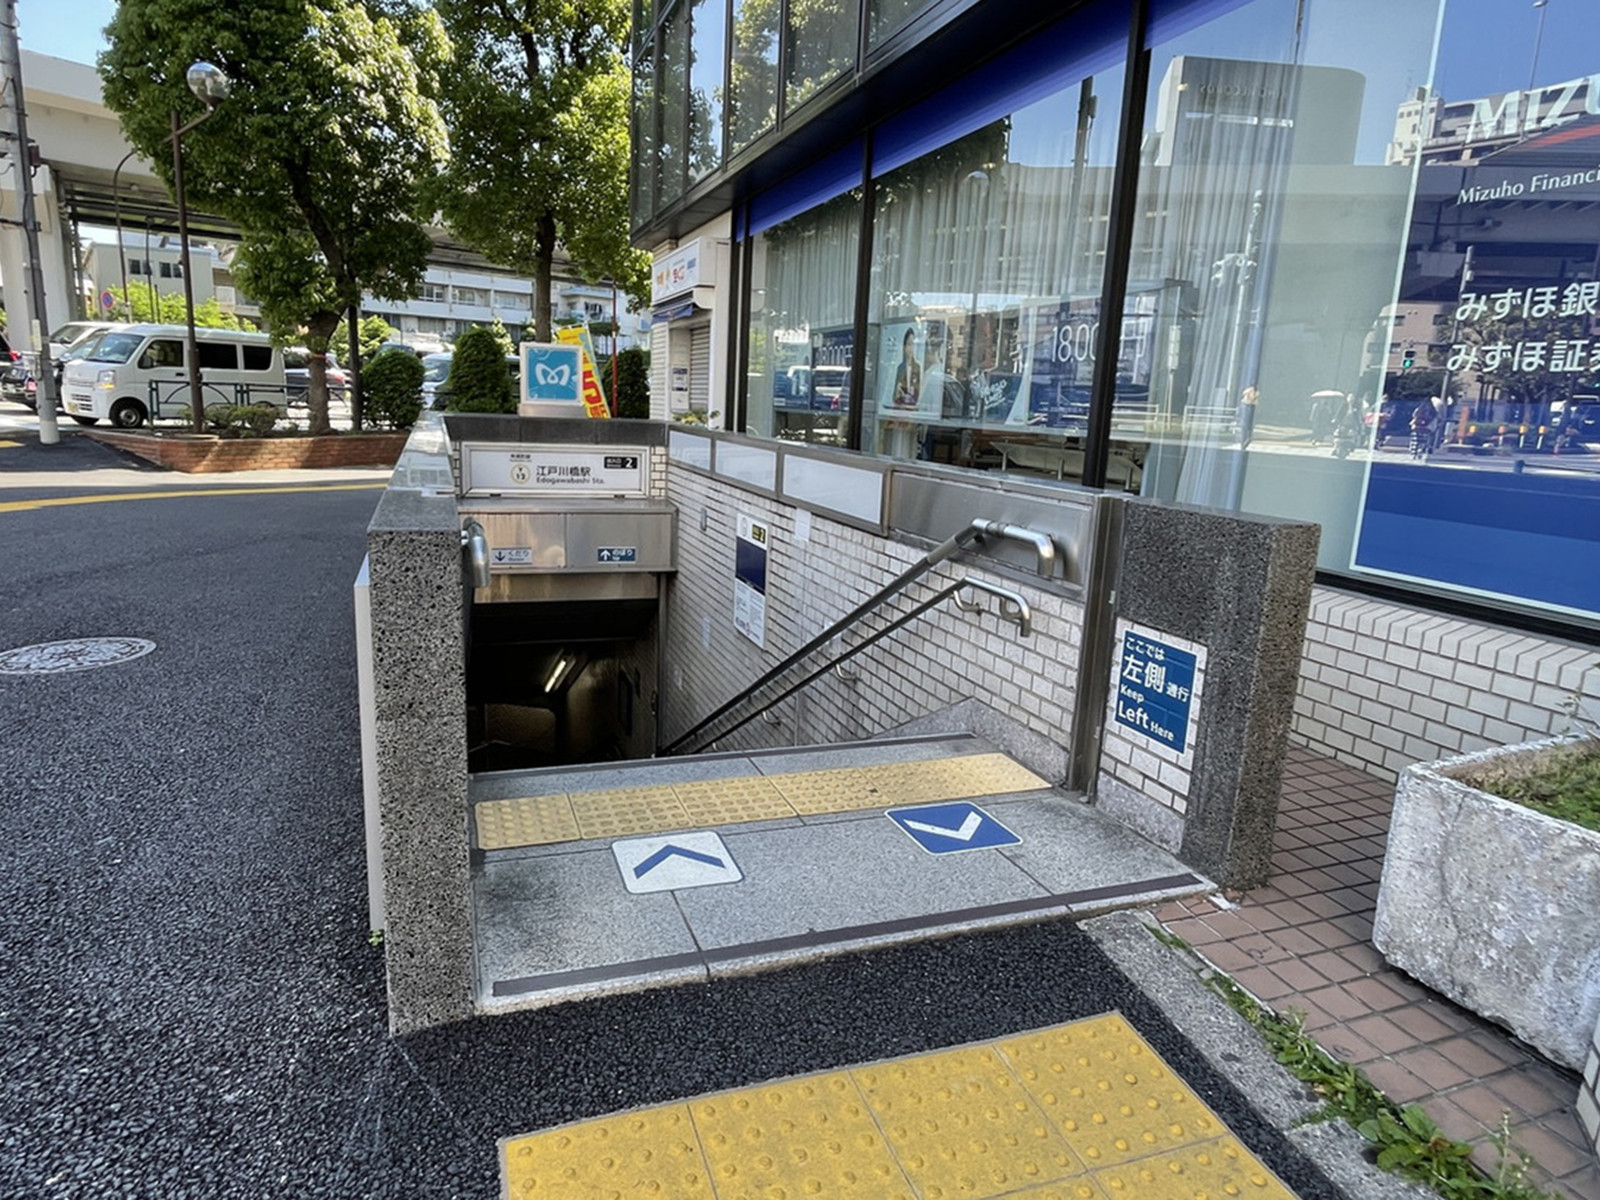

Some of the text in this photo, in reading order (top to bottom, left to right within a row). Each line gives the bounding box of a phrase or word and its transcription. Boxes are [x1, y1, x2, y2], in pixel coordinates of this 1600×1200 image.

[1456, 180, 1524, 205] Mizuho
[1456, 281, 1600, 321] みずほ銀
[536, 465, 591, 477] 江戸川橋駅
[625, 457, 633, 468] 2
[1126, 637, 1165, 661] ここでは
[1120, 683, 1144, 704] Keep
[1118, 700, 1175, 742] Left Here
